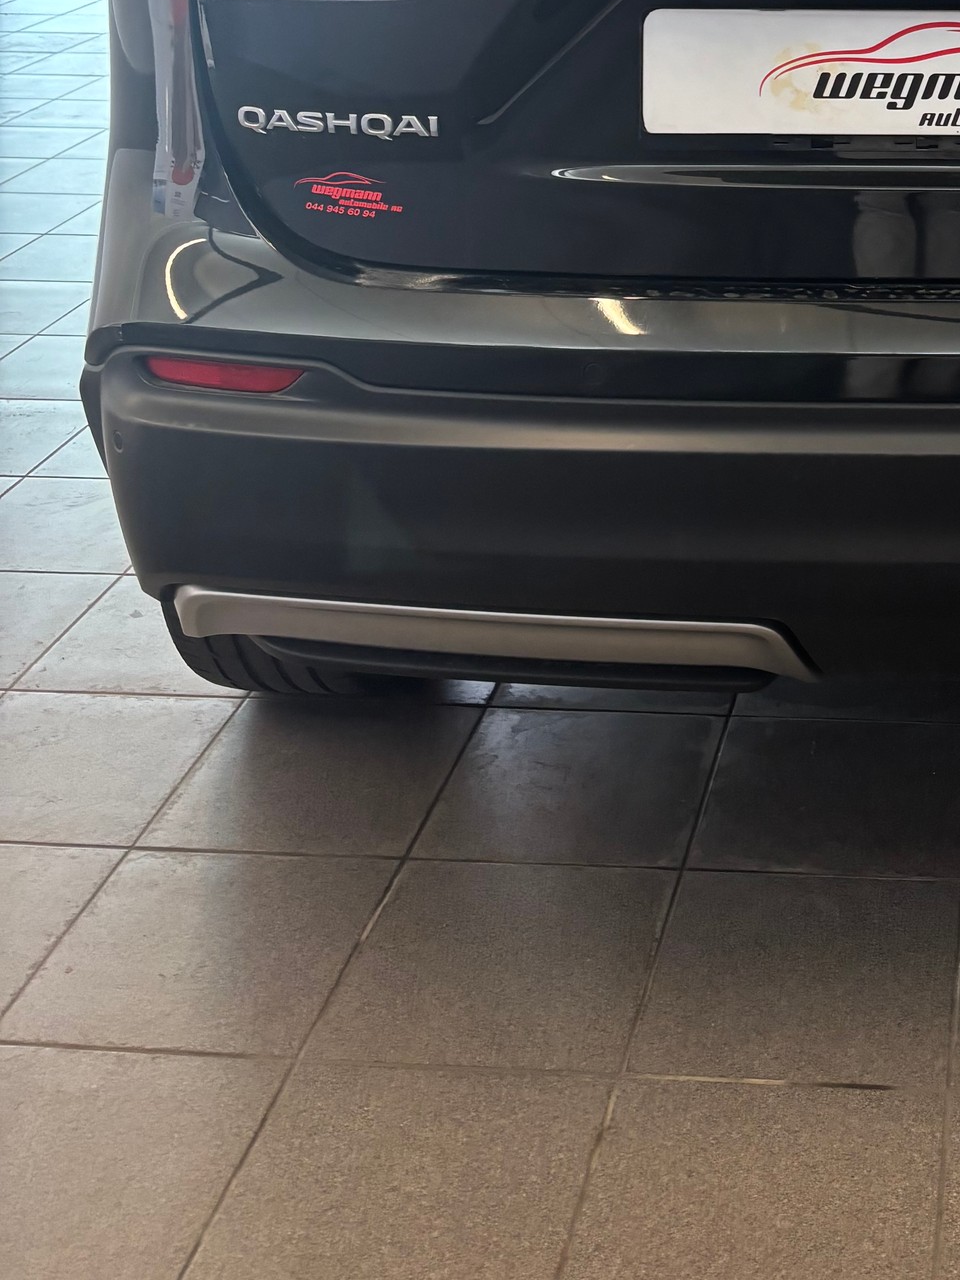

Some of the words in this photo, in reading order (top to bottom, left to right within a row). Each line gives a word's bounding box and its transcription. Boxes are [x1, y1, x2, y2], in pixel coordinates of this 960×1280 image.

[237, 105, 439, 141] QASHQAI
[311, 184, 382, 201] wegmann
[305, 202, 324, 211] 044
[326, 205, 345, 214] 945
[347, 208, 361, 216] 60
[362, 210, 376, 218] 94
